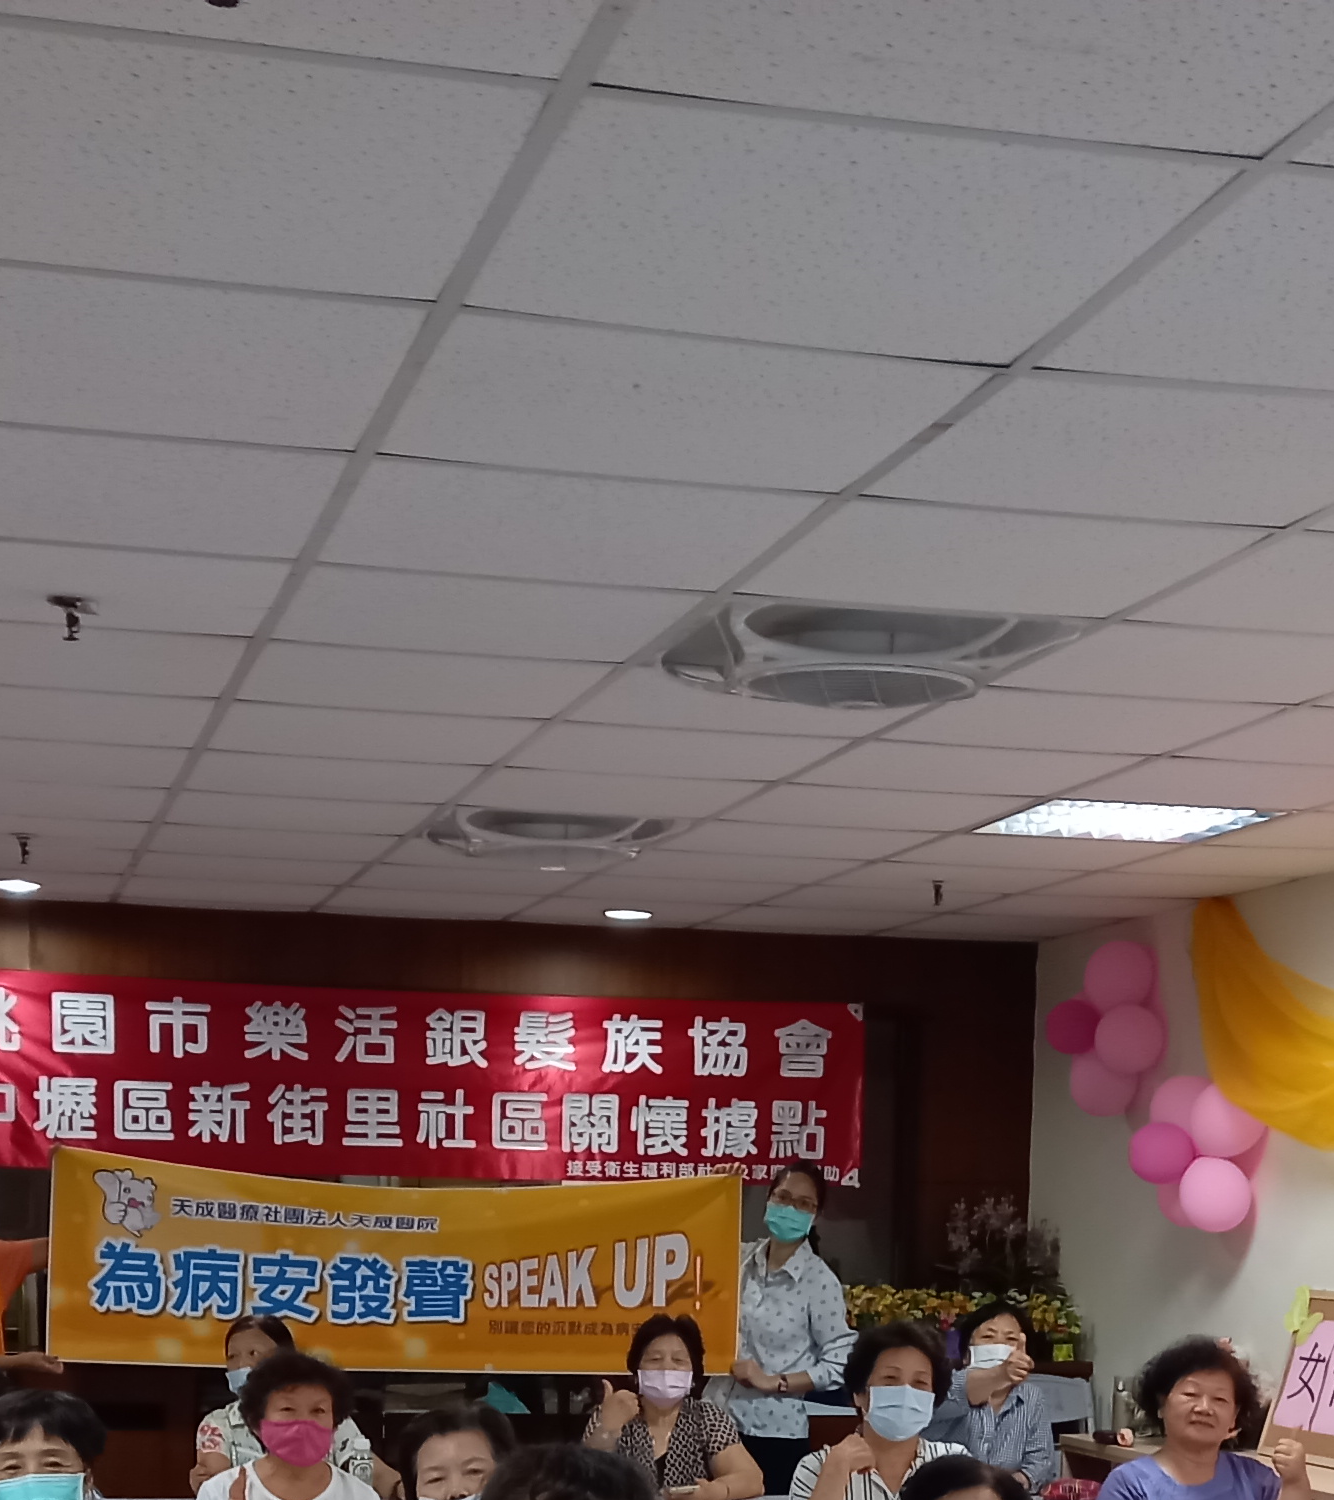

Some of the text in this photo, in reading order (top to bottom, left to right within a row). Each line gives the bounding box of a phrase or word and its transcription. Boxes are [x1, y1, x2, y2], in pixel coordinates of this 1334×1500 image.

[171, 1197, 440, 1232] 天成醫療社團法人天晟醫院
[91, 1236, 475, 1326] 為病安發聲
[483, 1245, 598, 1309] SPEAK
